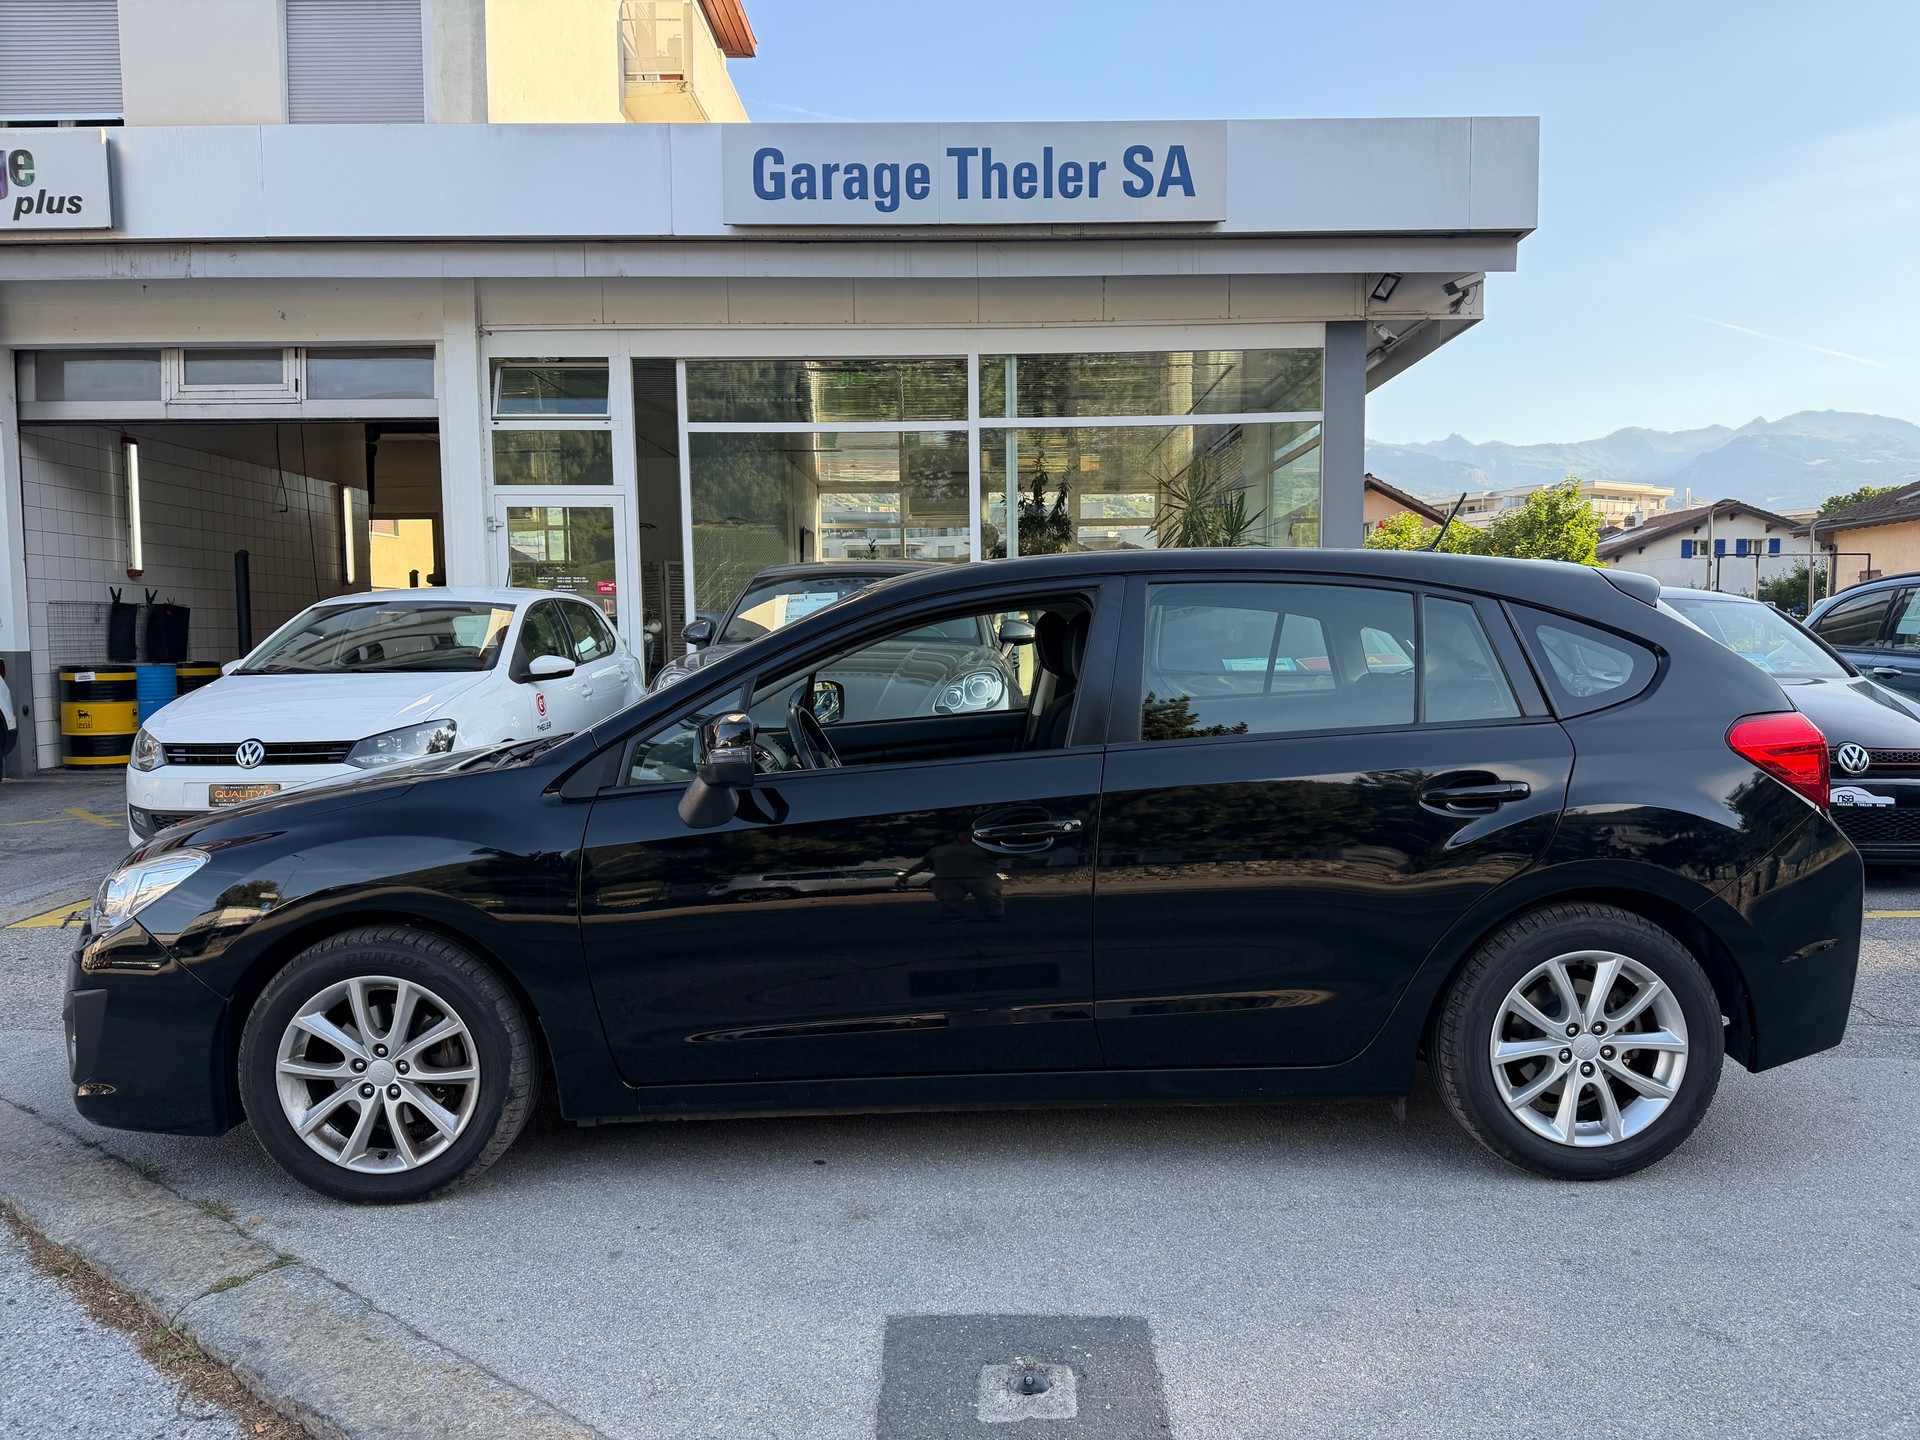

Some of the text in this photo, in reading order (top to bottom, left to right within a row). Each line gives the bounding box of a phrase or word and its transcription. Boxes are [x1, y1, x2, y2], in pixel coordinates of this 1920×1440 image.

[752, 145, 1196, 212] Garage Theler SA
[13, 189, 83, 221] plus
[214, 790, 261, 798] QUALITY
[1837, 794, 1854, 803] nsa
[345, 951, 428, 970] DUNLOP
